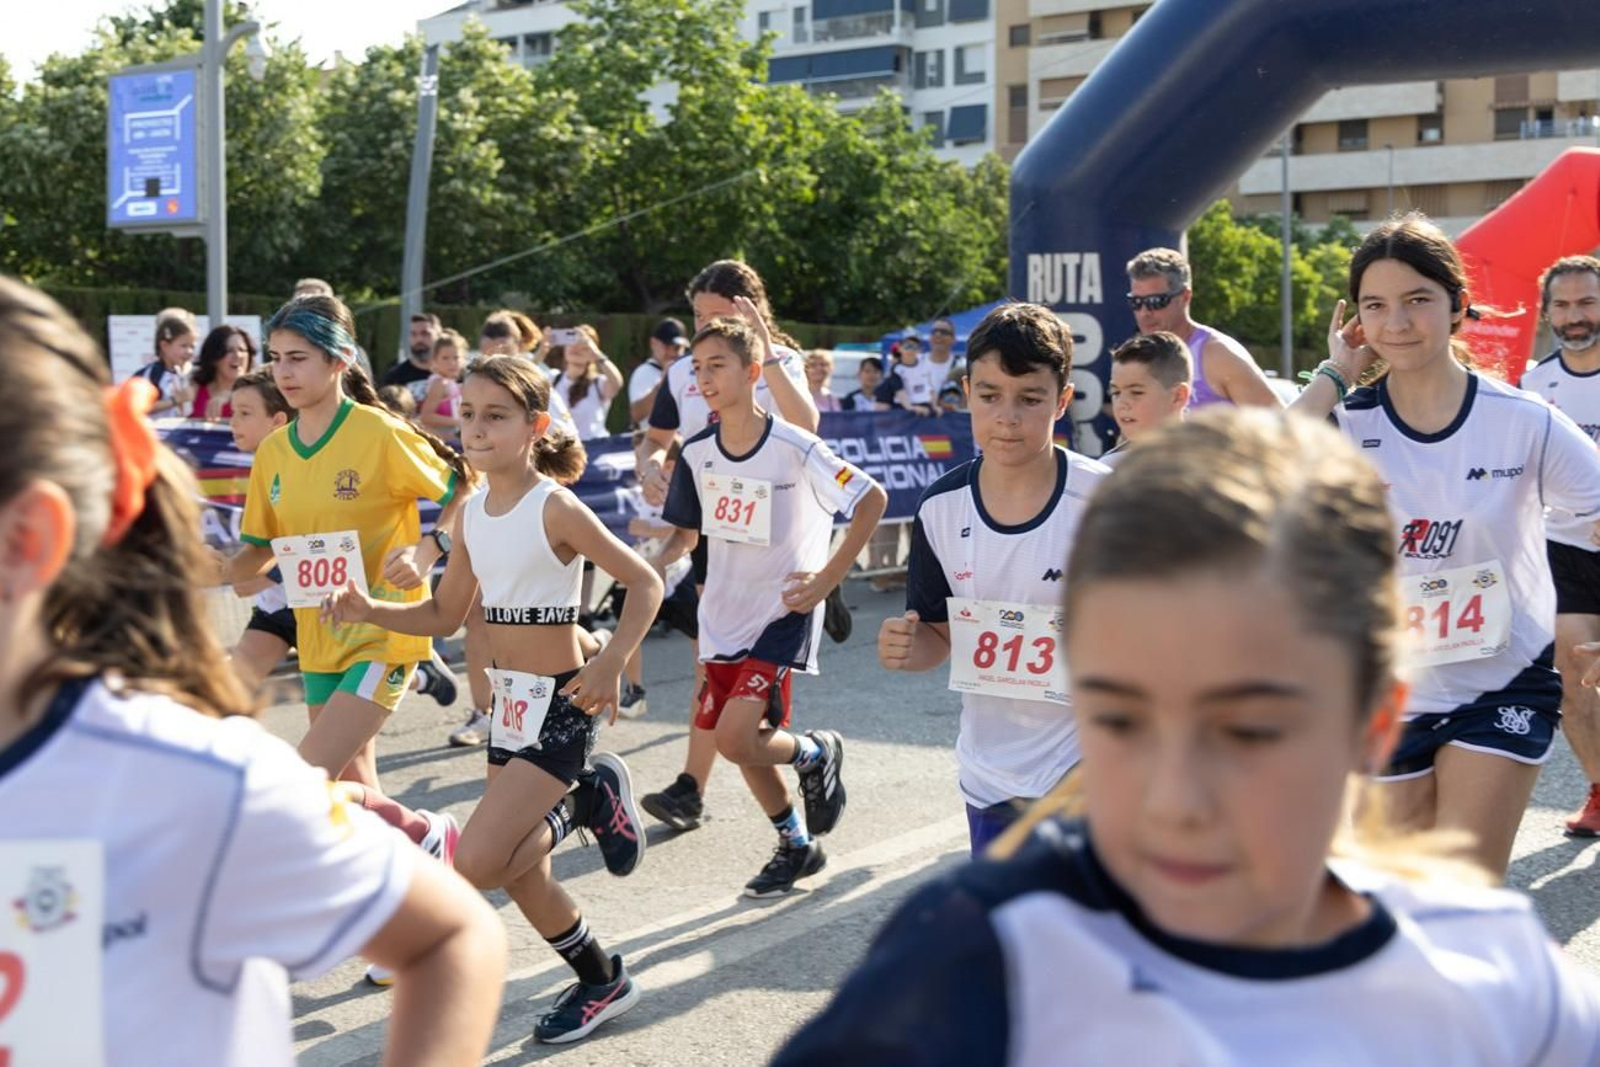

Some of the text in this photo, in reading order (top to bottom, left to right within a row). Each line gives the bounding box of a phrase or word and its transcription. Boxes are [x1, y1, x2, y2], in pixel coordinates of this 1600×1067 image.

[1027, 252, 1103, 304] RUTA
[714, 495, 756, 526] 831
[297, 555, 347, 588] 808
[496, 607, 530, 623] LOVE
[1402, 593, 1486, 640] 814
[972, 631, 1056, 675] 813
